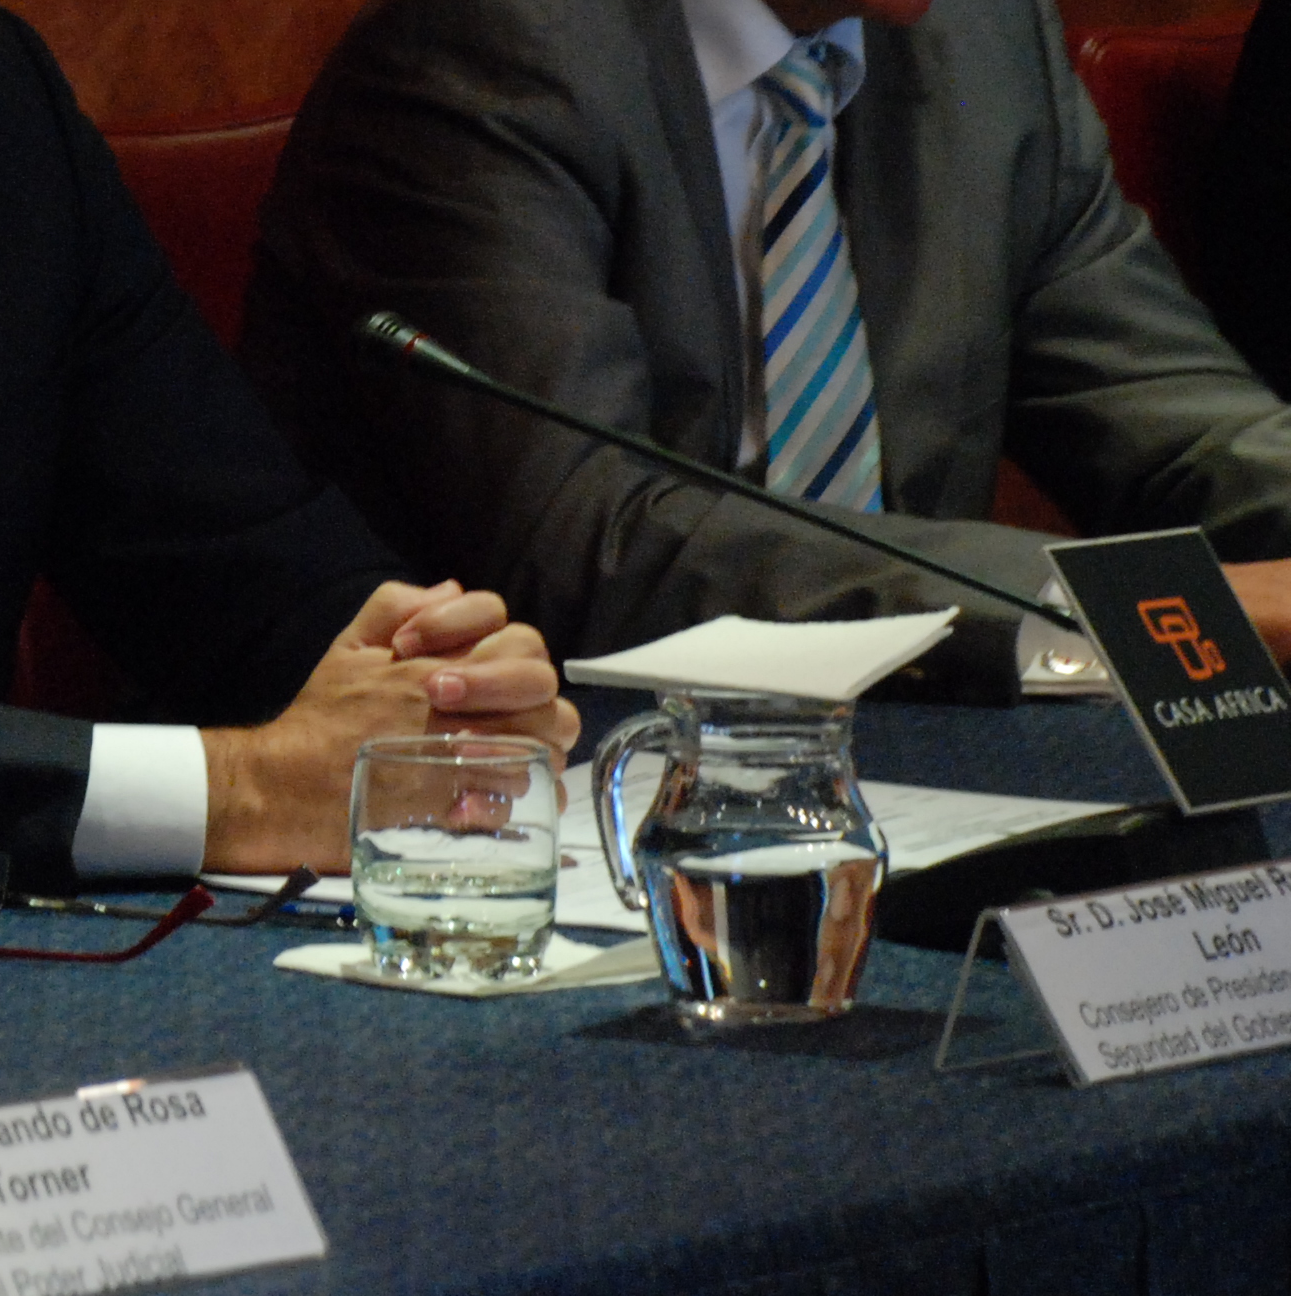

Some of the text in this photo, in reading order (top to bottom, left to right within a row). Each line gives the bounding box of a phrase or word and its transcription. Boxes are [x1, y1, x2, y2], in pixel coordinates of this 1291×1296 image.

[1154, 686, 1287, 728] CASA AFRICA
[1046, 906, 1093, 939] Sr.
[1085, 900, 1124, 930] D.
[1180, 871, 1272, 914] Miguel
[1192, 923, 1263, 961] León
[1078, 990, 1181, 1031] Consejero
[1182, 982, 1209, 1009] de
[1098, 1026, 1201, 1074] Seguridad
[1201, 1019, 1232, 1050] del
[79, 1099, 119, 1133] de
[121, 1088, 207, 1128] Rosa
[29, 1214, 68, 1250] del
[70, 1200, 176, 1238] Consejo
[175, 1182, 276, 1226] General
[95, 1243, 187, 1289] Judicial
